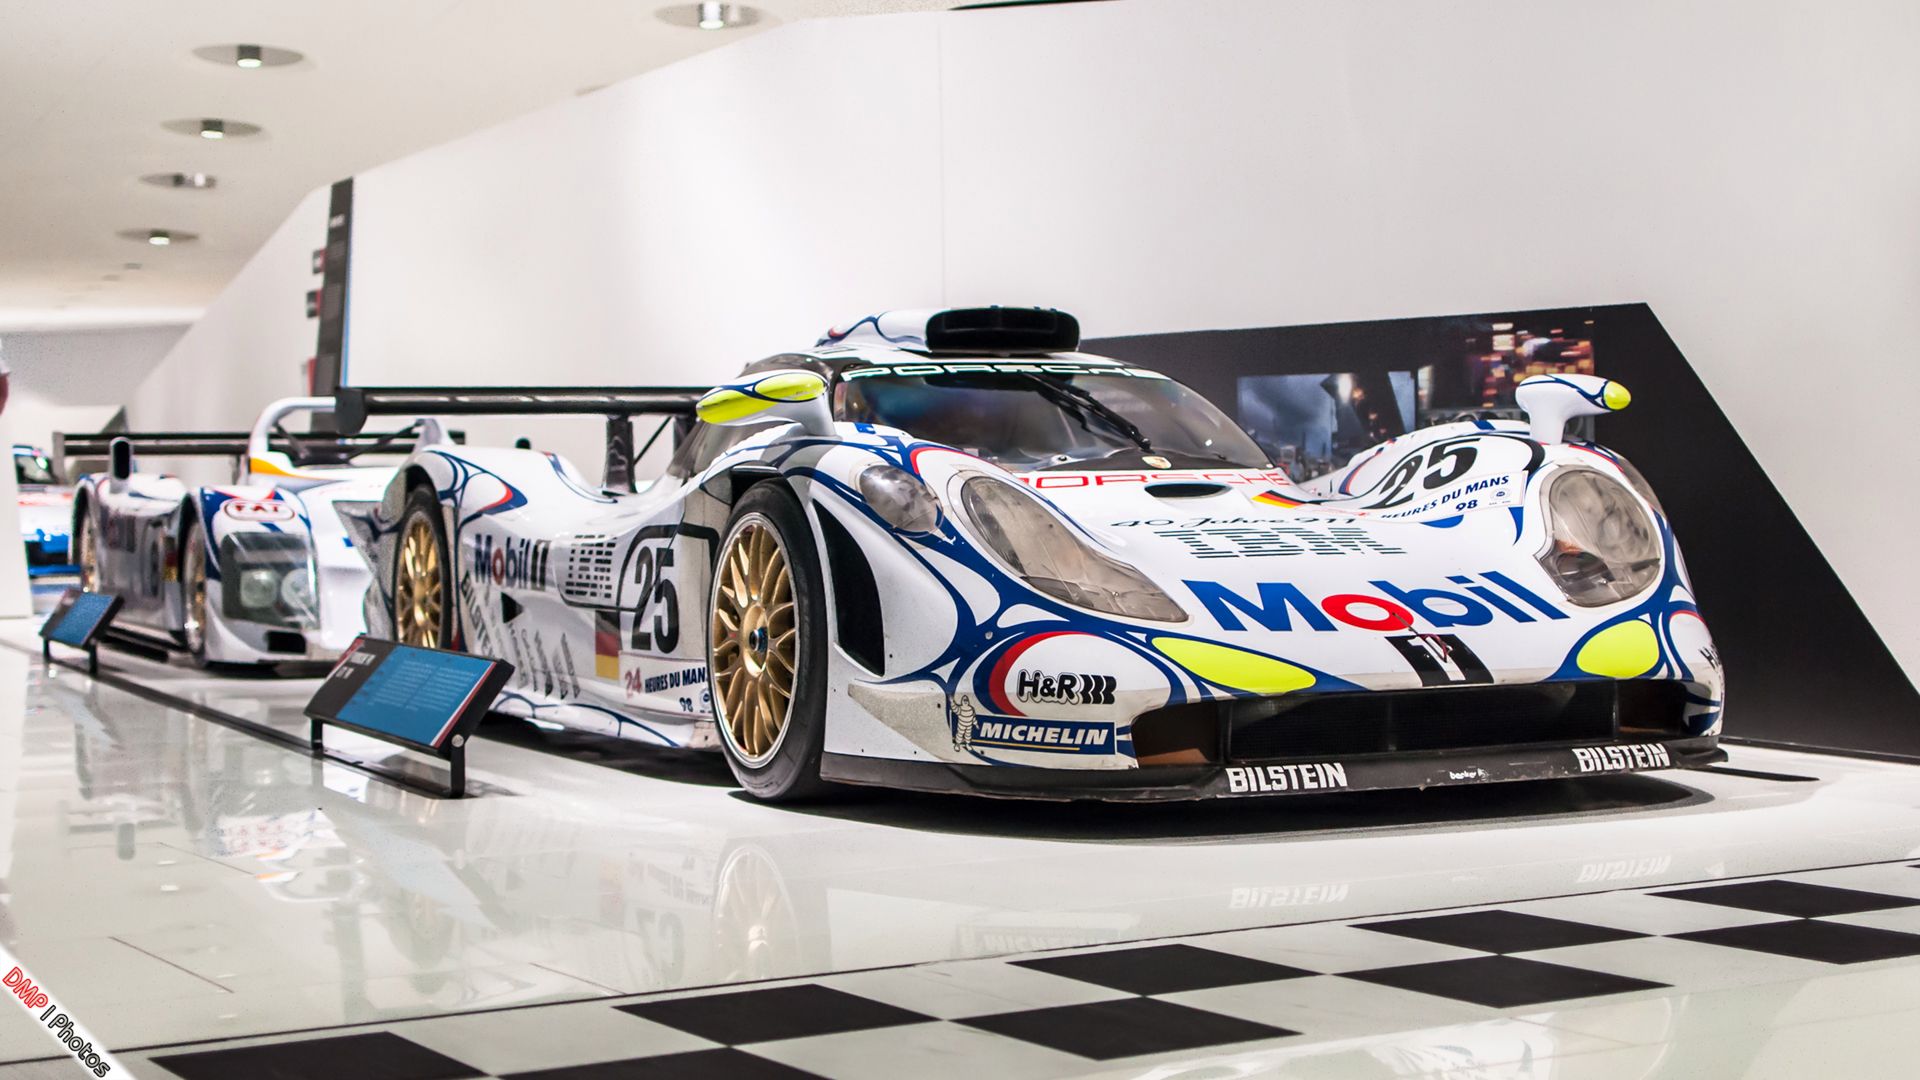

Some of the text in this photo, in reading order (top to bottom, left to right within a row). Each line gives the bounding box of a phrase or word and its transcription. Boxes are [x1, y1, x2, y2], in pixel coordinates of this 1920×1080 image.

[1360, 437, 1481, 510] 25
[1442, 486, 1463, 505] DU
[1465, 475, 1510, 496] MANS
[1455, 499, 1479, 512] 98
[1111, 518, 1175, 527] 40
[1180, 517, 1284, 528] Jahre
[1153, 527, 1407, 559] IBM
[475, 533, 531, 589] Mobil
[565, 534, 617, 599] IBM
[631, 546, 680, 654] 25
[1181, 570, 1571, 632] Mobil
[624, 667, 642, 697] 24
[669, 671, 681, 688] DU
[682, 667, 708, 686] MAN
[1017, 670, 1080, 703] H&R
[979, 722, 1109, 746] MICHELIN
[1572, 743, 1671, 773] BILSTEIN
[1225, 762, 1348, 793] BILSTEIN
